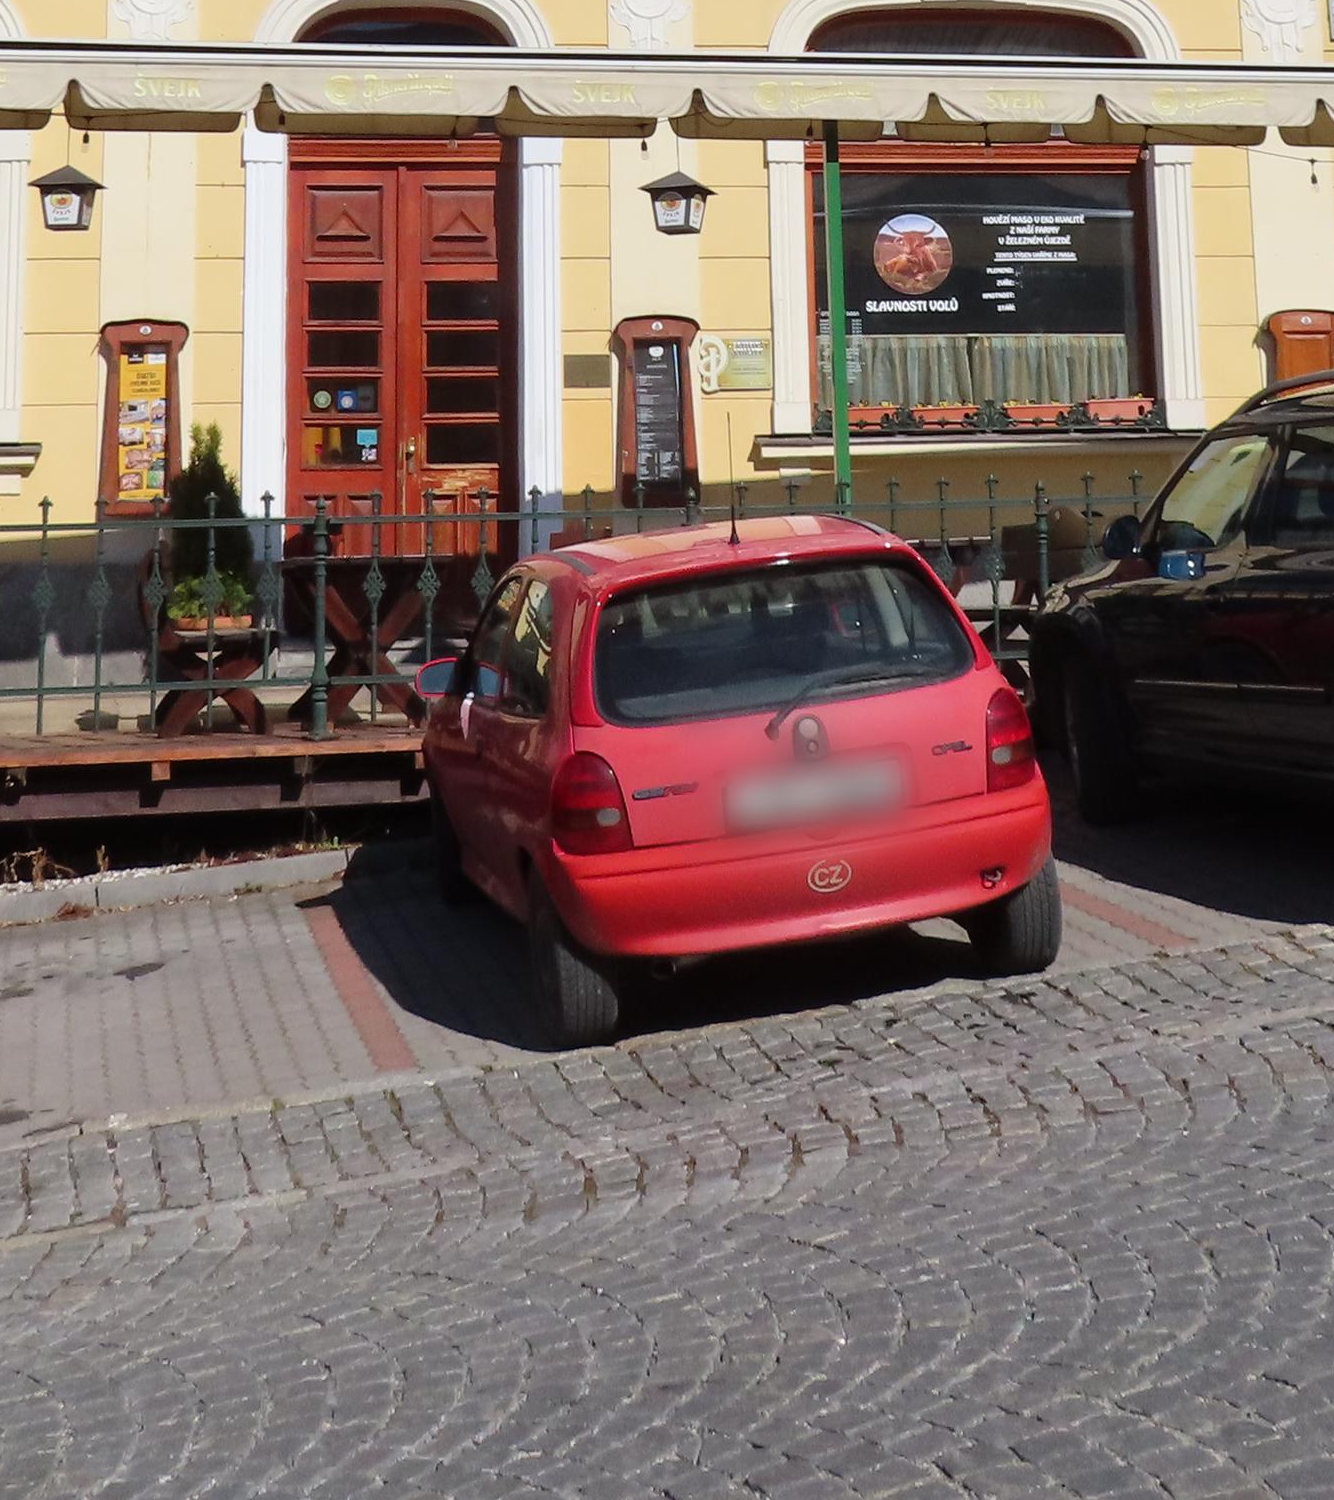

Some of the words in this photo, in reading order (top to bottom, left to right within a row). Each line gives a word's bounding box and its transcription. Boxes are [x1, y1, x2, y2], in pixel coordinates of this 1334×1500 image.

[133, 73, 203, 99] ŠVEJK
[865, 300, 928, 313] SLAVNOSTI
[929, 297, 959, 312] VOLŮ
[814, 864, 844, 887] CZ
